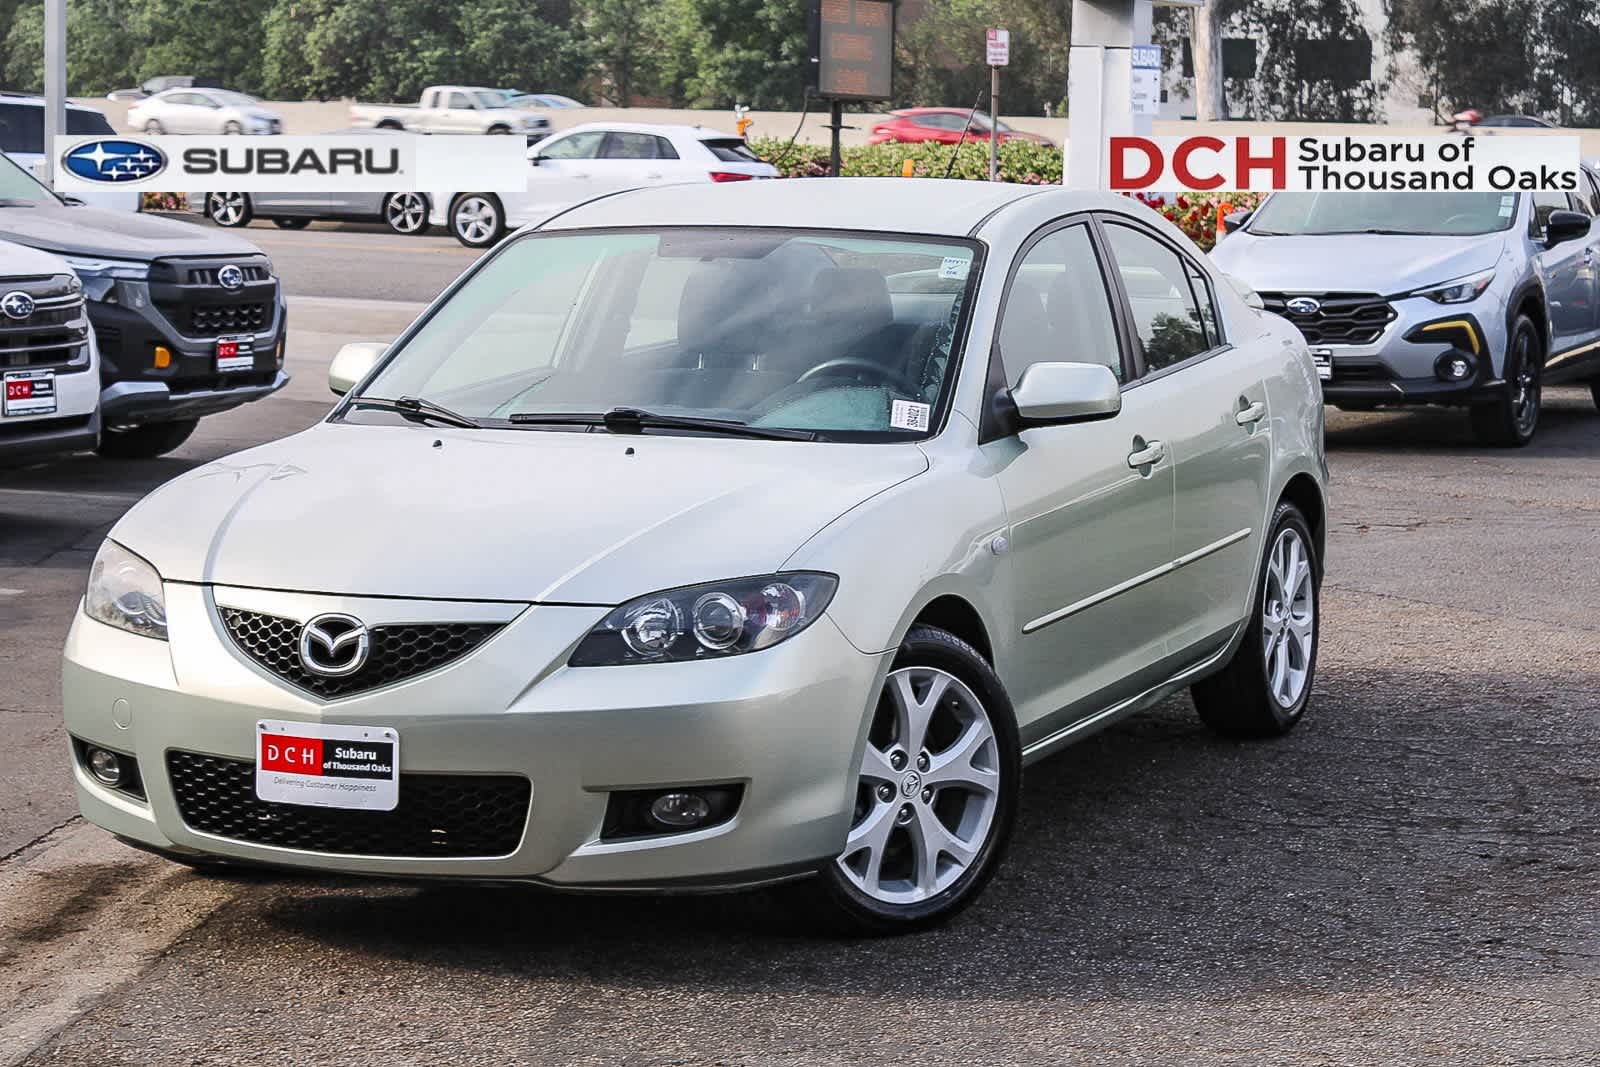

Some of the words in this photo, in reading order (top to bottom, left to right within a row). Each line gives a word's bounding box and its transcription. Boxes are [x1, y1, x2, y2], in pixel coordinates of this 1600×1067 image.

[335, 747, 377, 760] Subaru
[323, 761, 332, 769] of
[332, 761, 370, 772] Thousand
[371, 764, 392, 773] Oaks
[273, 776, 304, 788] Delivering
[306, 780, 338, 789] Customer
[338, 783, 377, 792] Happiness
